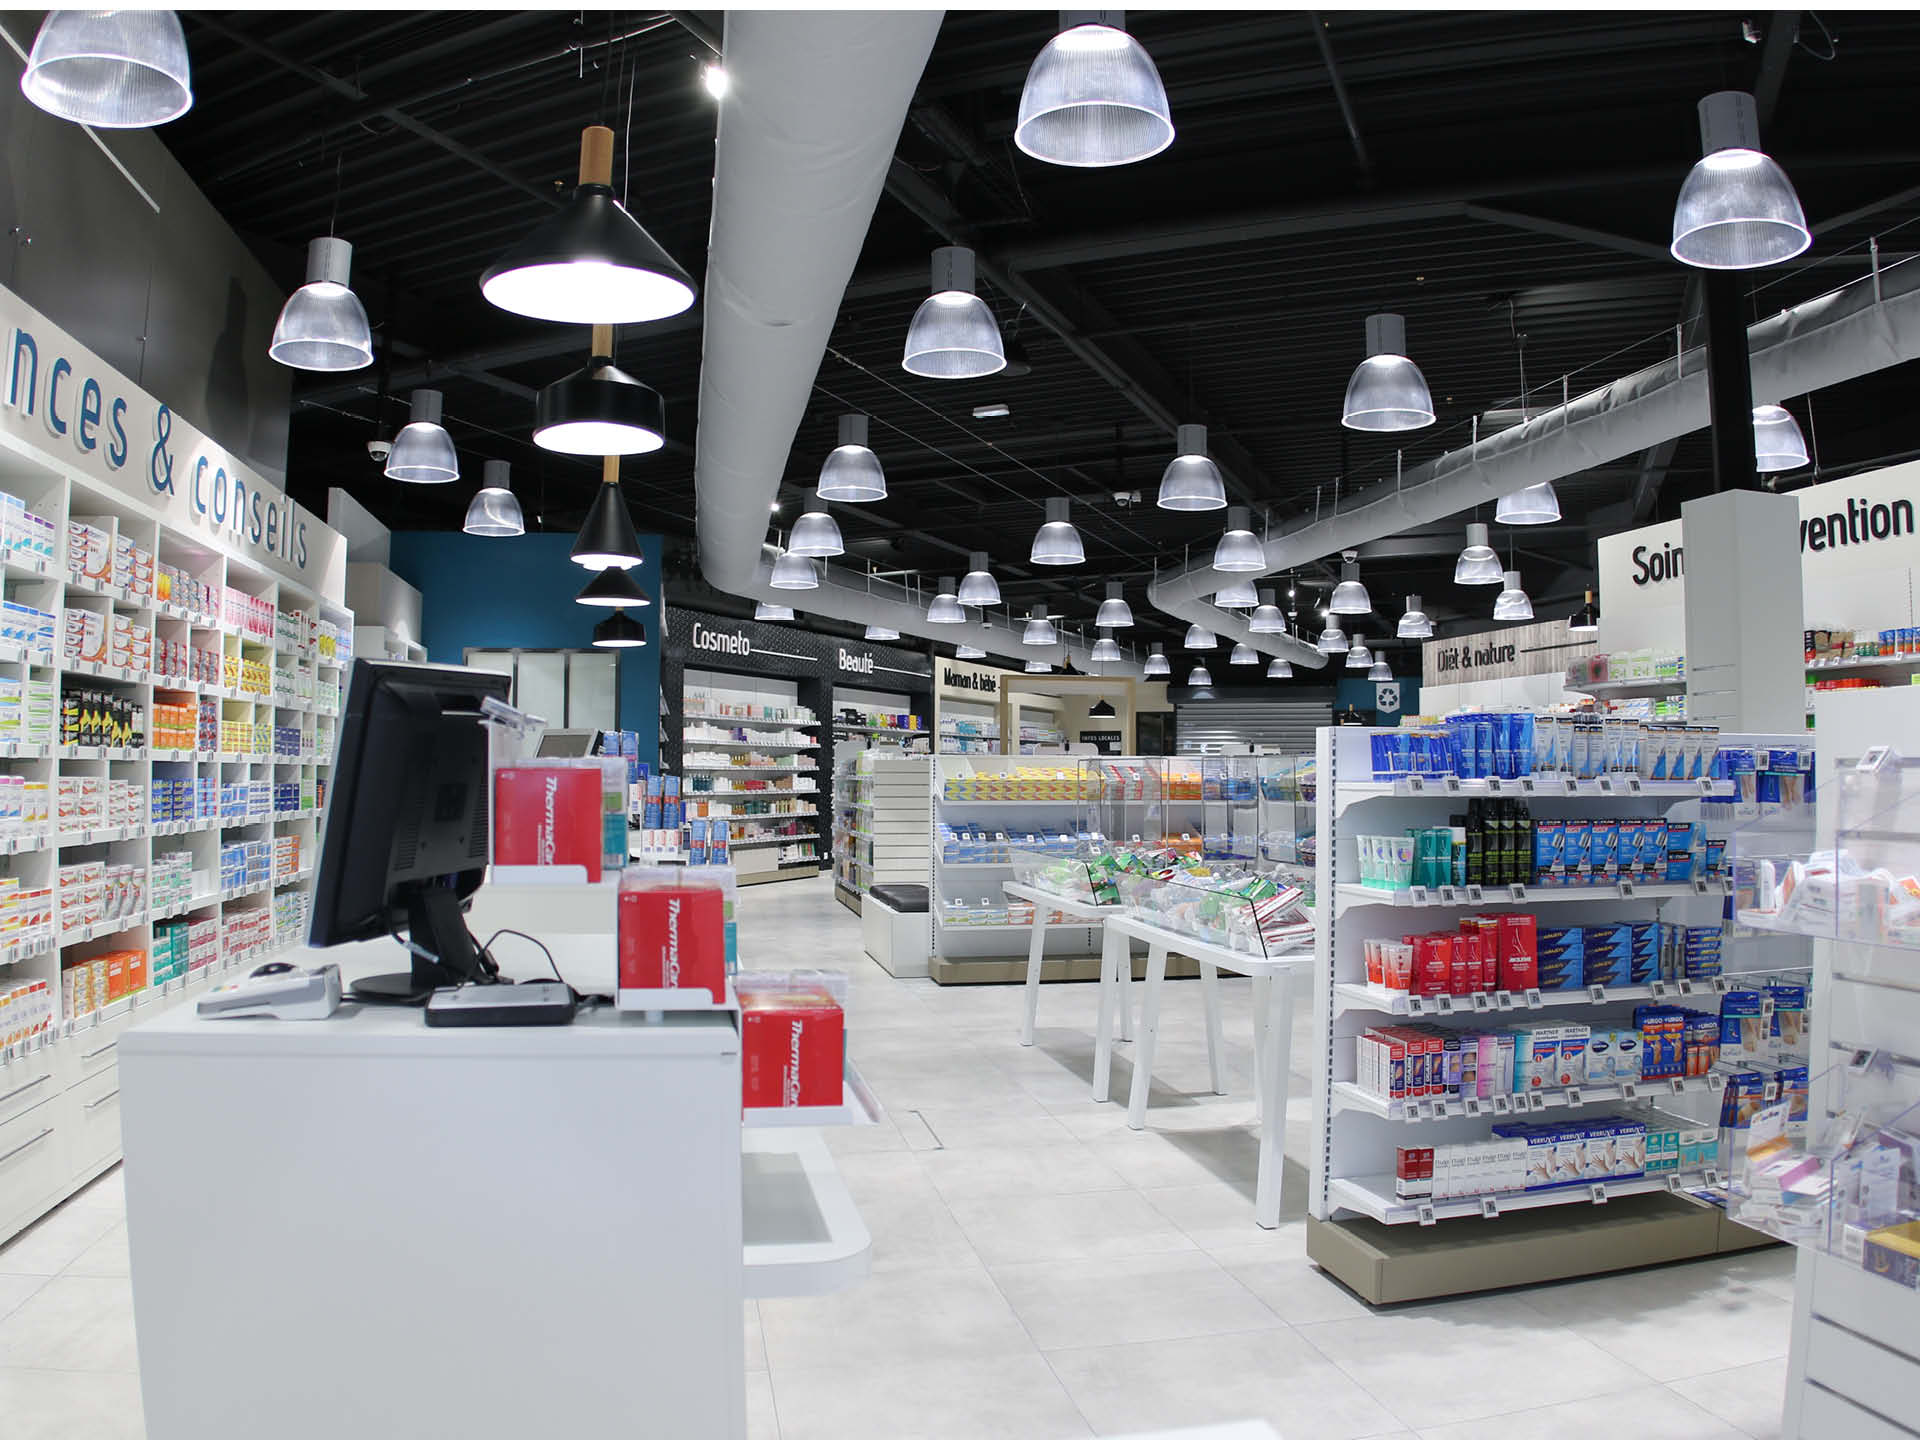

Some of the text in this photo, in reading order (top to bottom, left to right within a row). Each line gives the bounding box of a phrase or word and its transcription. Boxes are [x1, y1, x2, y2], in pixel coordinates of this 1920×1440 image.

[149, 404, 175, 497] &
[191, 456, 308, 569] conseils
[692, 622, 751, 657] Cosmeto
[838, 649, 874, 675] Beauté
[1437, 642, 1515, 672] Diét & nature
[944, 668, 997, 693] Maman & bébé
